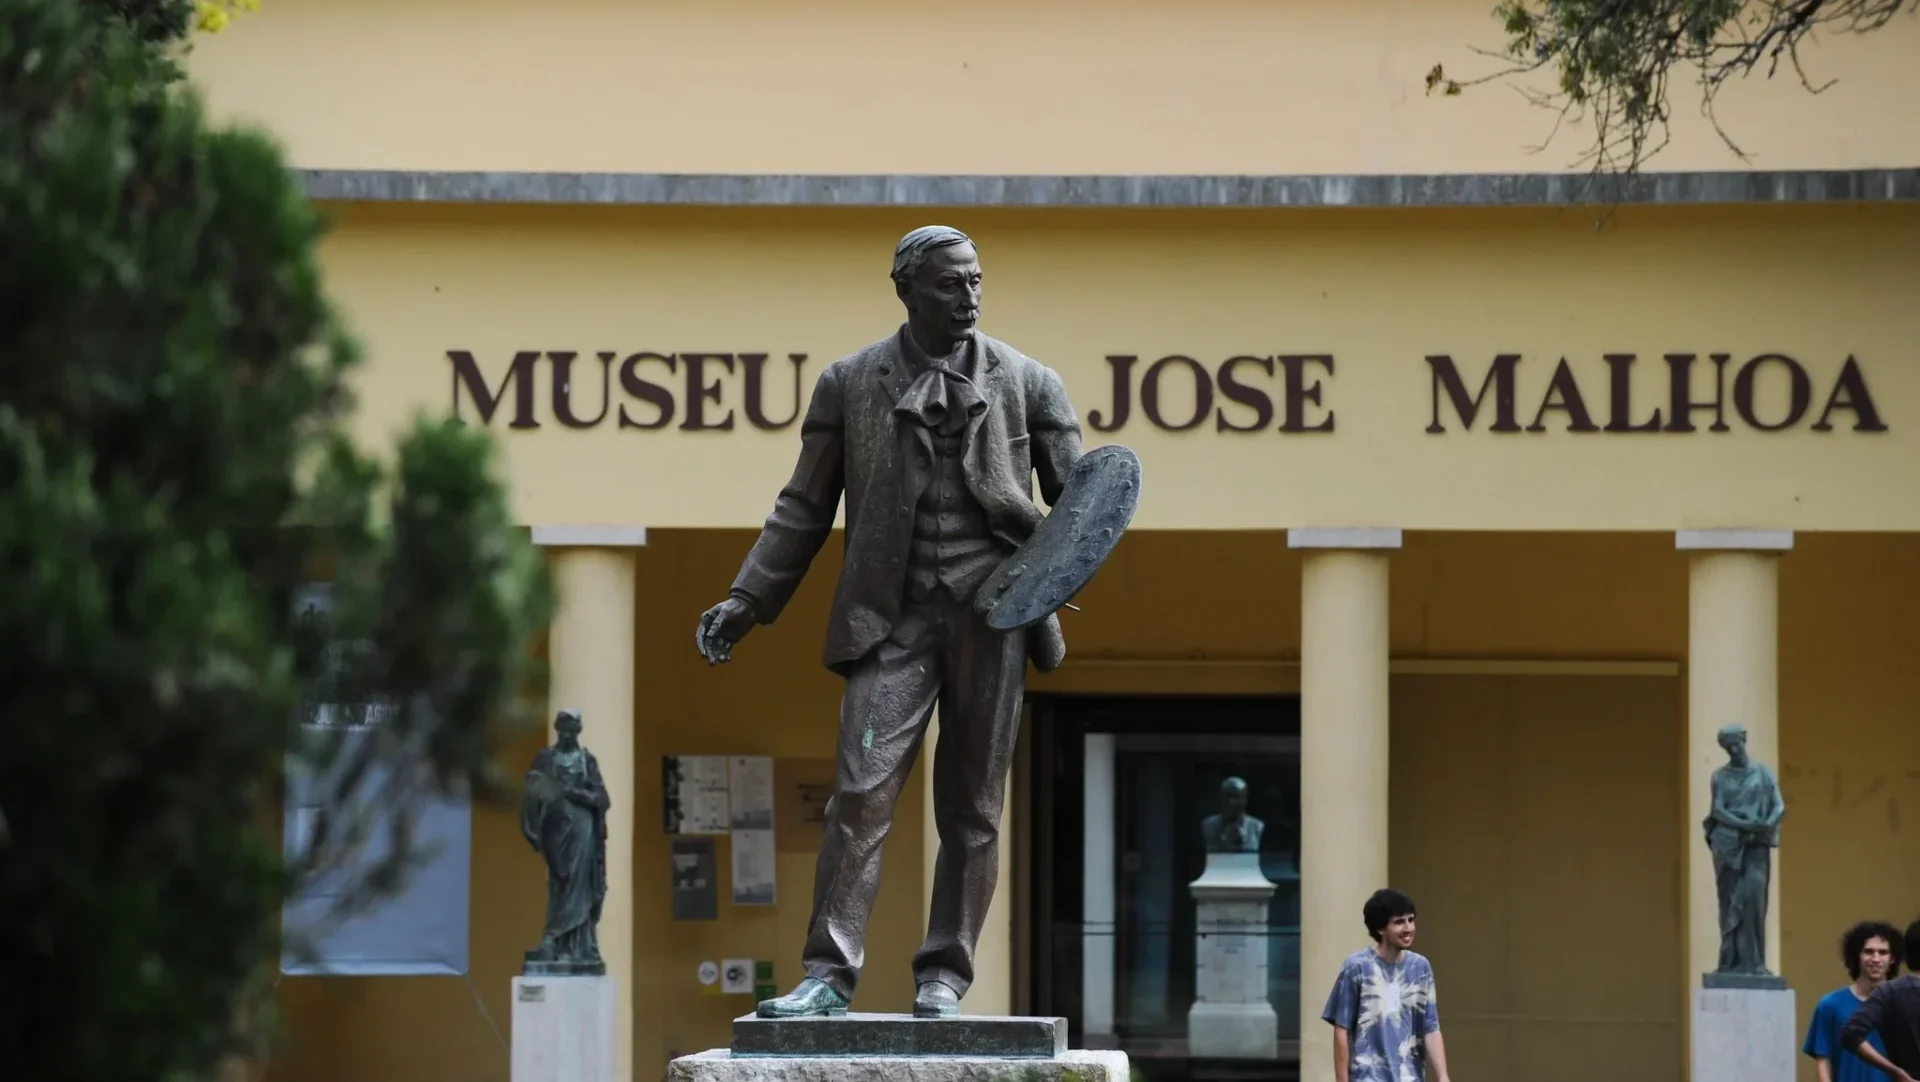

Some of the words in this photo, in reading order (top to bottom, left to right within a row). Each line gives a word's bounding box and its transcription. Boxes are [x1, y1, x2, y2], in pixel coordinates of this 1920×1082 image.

[445, 350, 808, 432] MUSEU
[1087, 354, 1335, 434] JOSE
[1424, 353, 1889, 434] MALHOA
